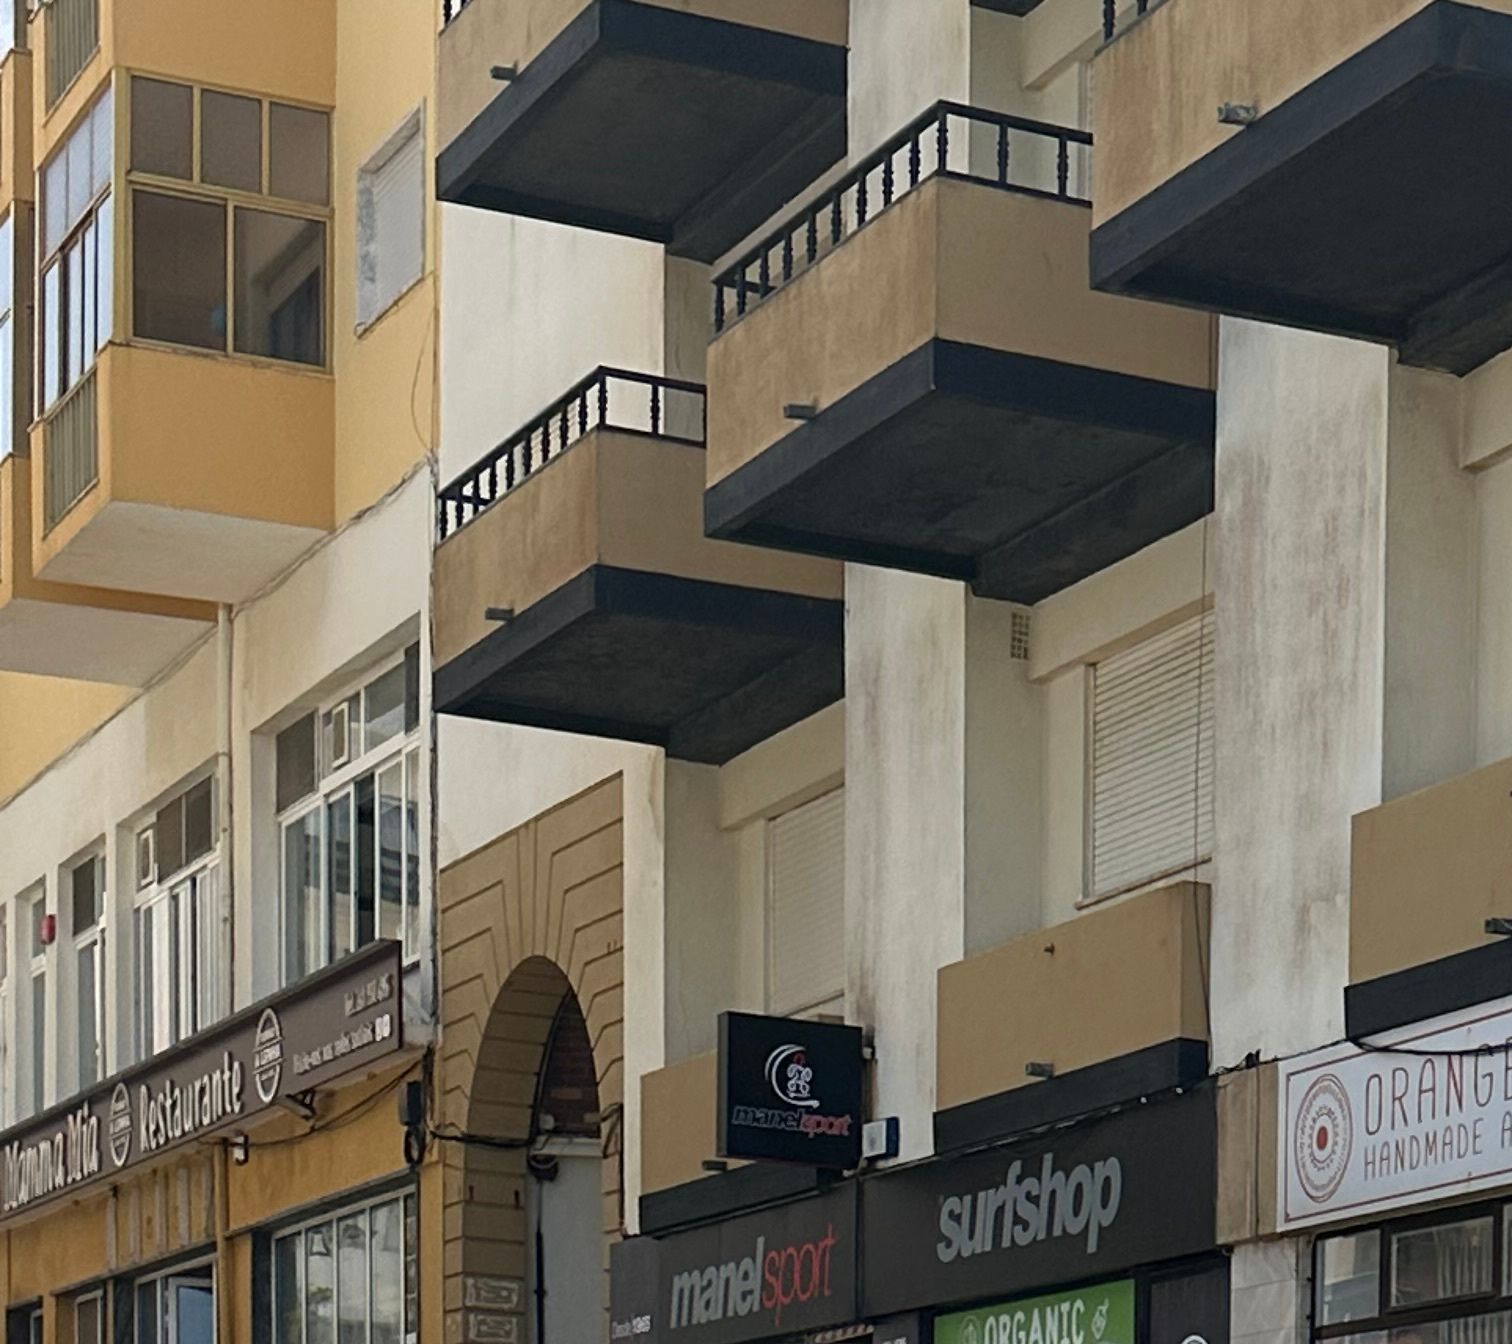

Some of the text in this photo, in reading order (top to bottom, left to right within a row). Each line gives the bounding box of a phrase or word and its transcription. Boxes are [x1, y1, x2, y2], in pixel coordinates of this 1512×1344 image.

[66, 1100, 100, 1185] Mia
[139, 1050, 245, 1153] Restaurante
[1363, 1117, 1485, 1182] HANDMADE
[936, 1152, 1122, 1264] surfshop
